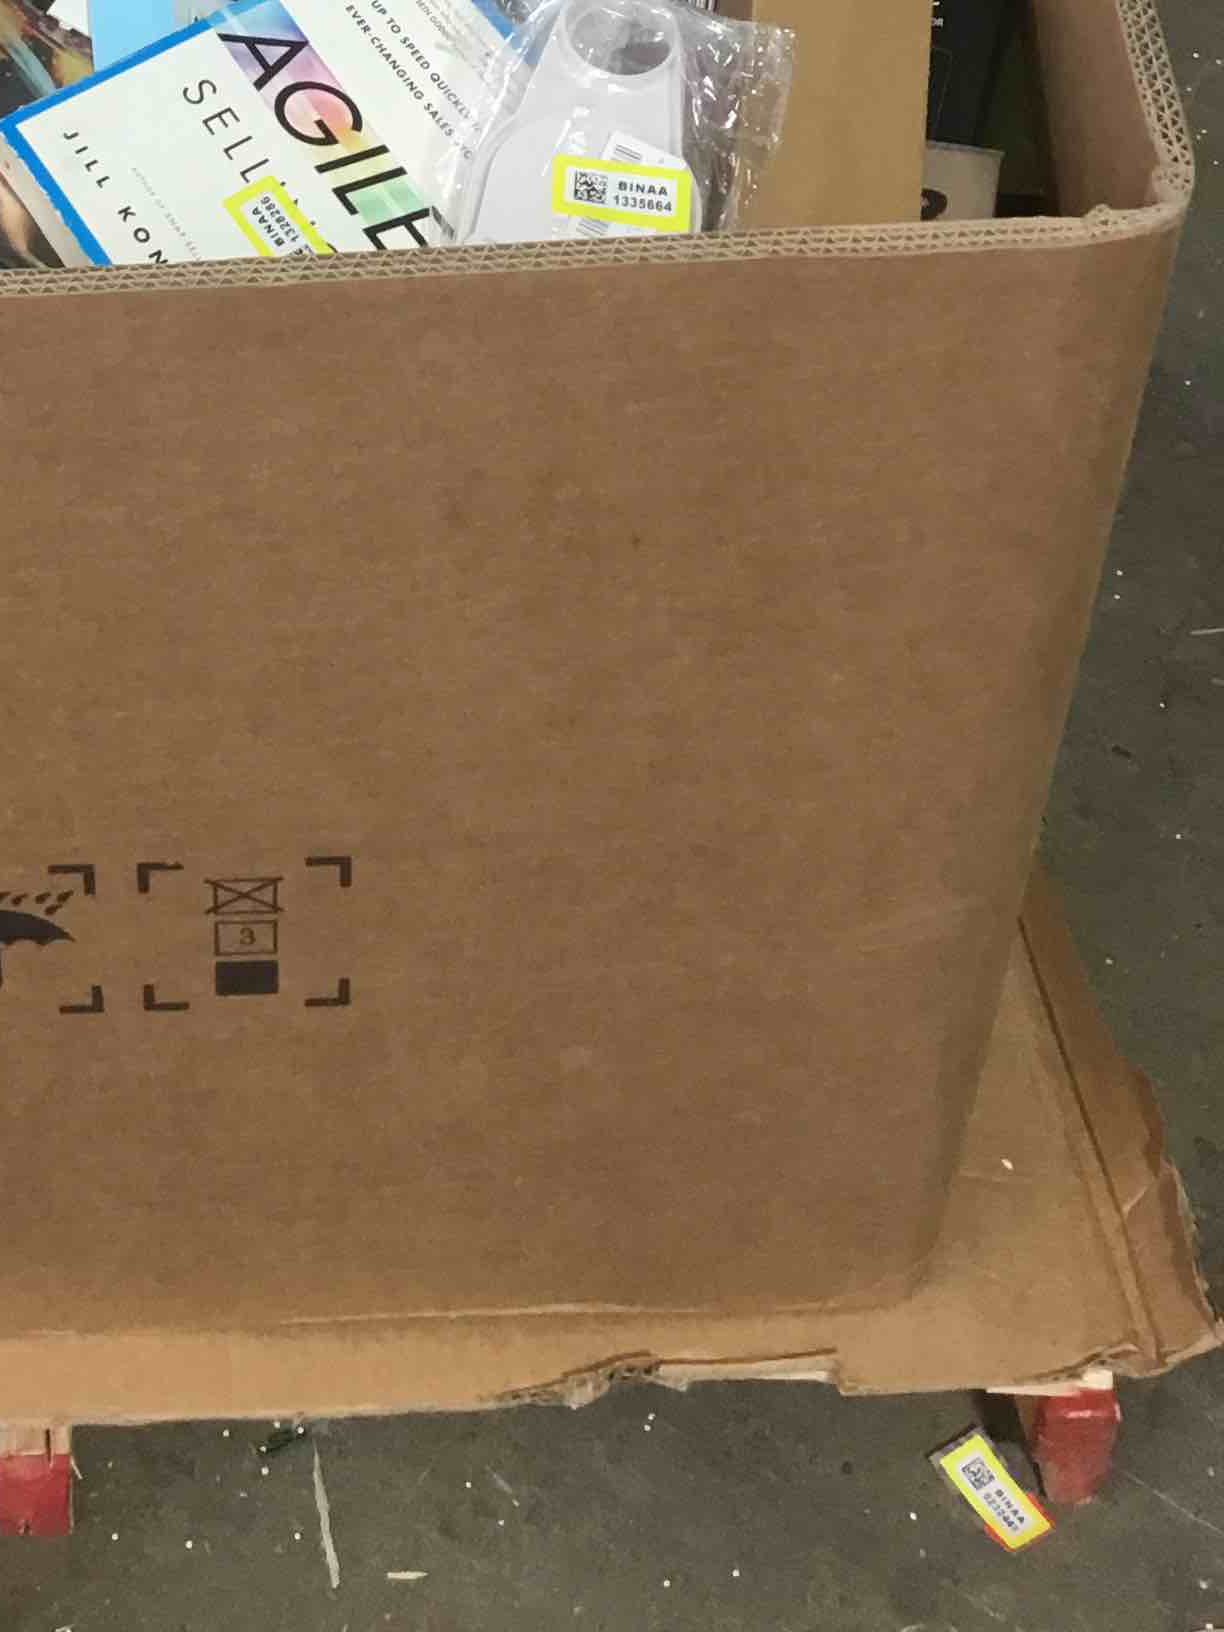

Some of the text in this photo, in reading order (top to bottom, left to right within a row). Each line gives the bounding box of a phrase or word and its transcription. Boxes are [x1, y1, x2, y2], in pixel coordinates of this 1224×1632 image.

[345, 3, 456, 138] EVER-CHANGING SALES
[370, 0, 388, 16] UP
[386, 16, 401, 35] TO
[399, 35, 430, 71] SPEED
[429, 71, 473, 120] QUICKLY
[63, 129, 112, 190] JILL
[217, 32, 444, 250] AGILE
[617, 180, 668, 197] BINAA
[250, 206, 286, 247] BINAA
[994, 1488, 1025, 1524] BINAA
